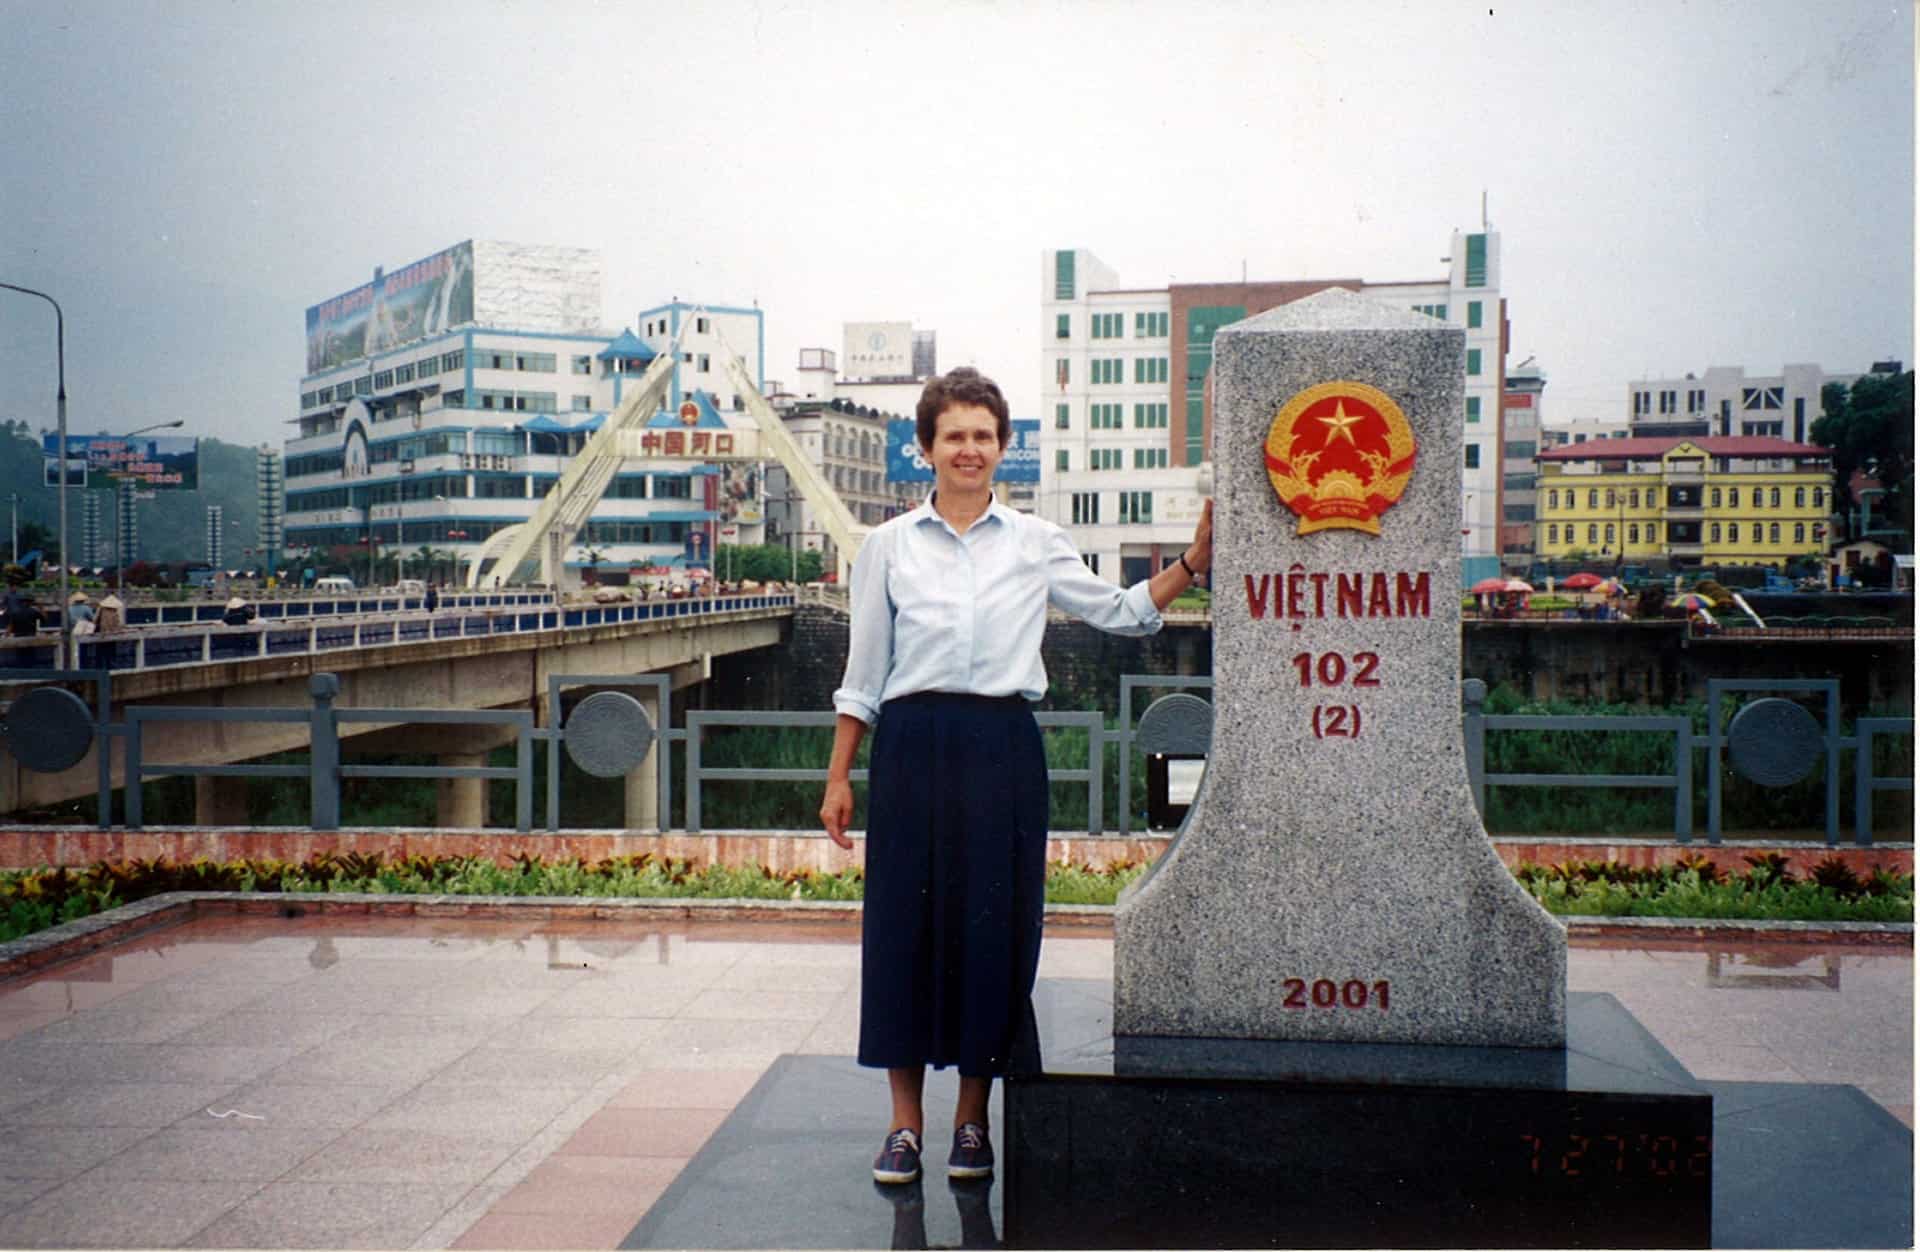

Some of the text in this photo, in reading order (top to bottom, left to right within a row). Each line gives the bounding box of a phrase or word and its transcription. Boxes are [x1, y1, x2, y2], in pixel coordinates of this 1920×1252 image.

[641, 430, 734, 456] 中国河口
[1292, 651, 1381, 688] 102
[1312, 704, 1361, 739] (2)
[1283, 978, 1390, 1010] 2001
